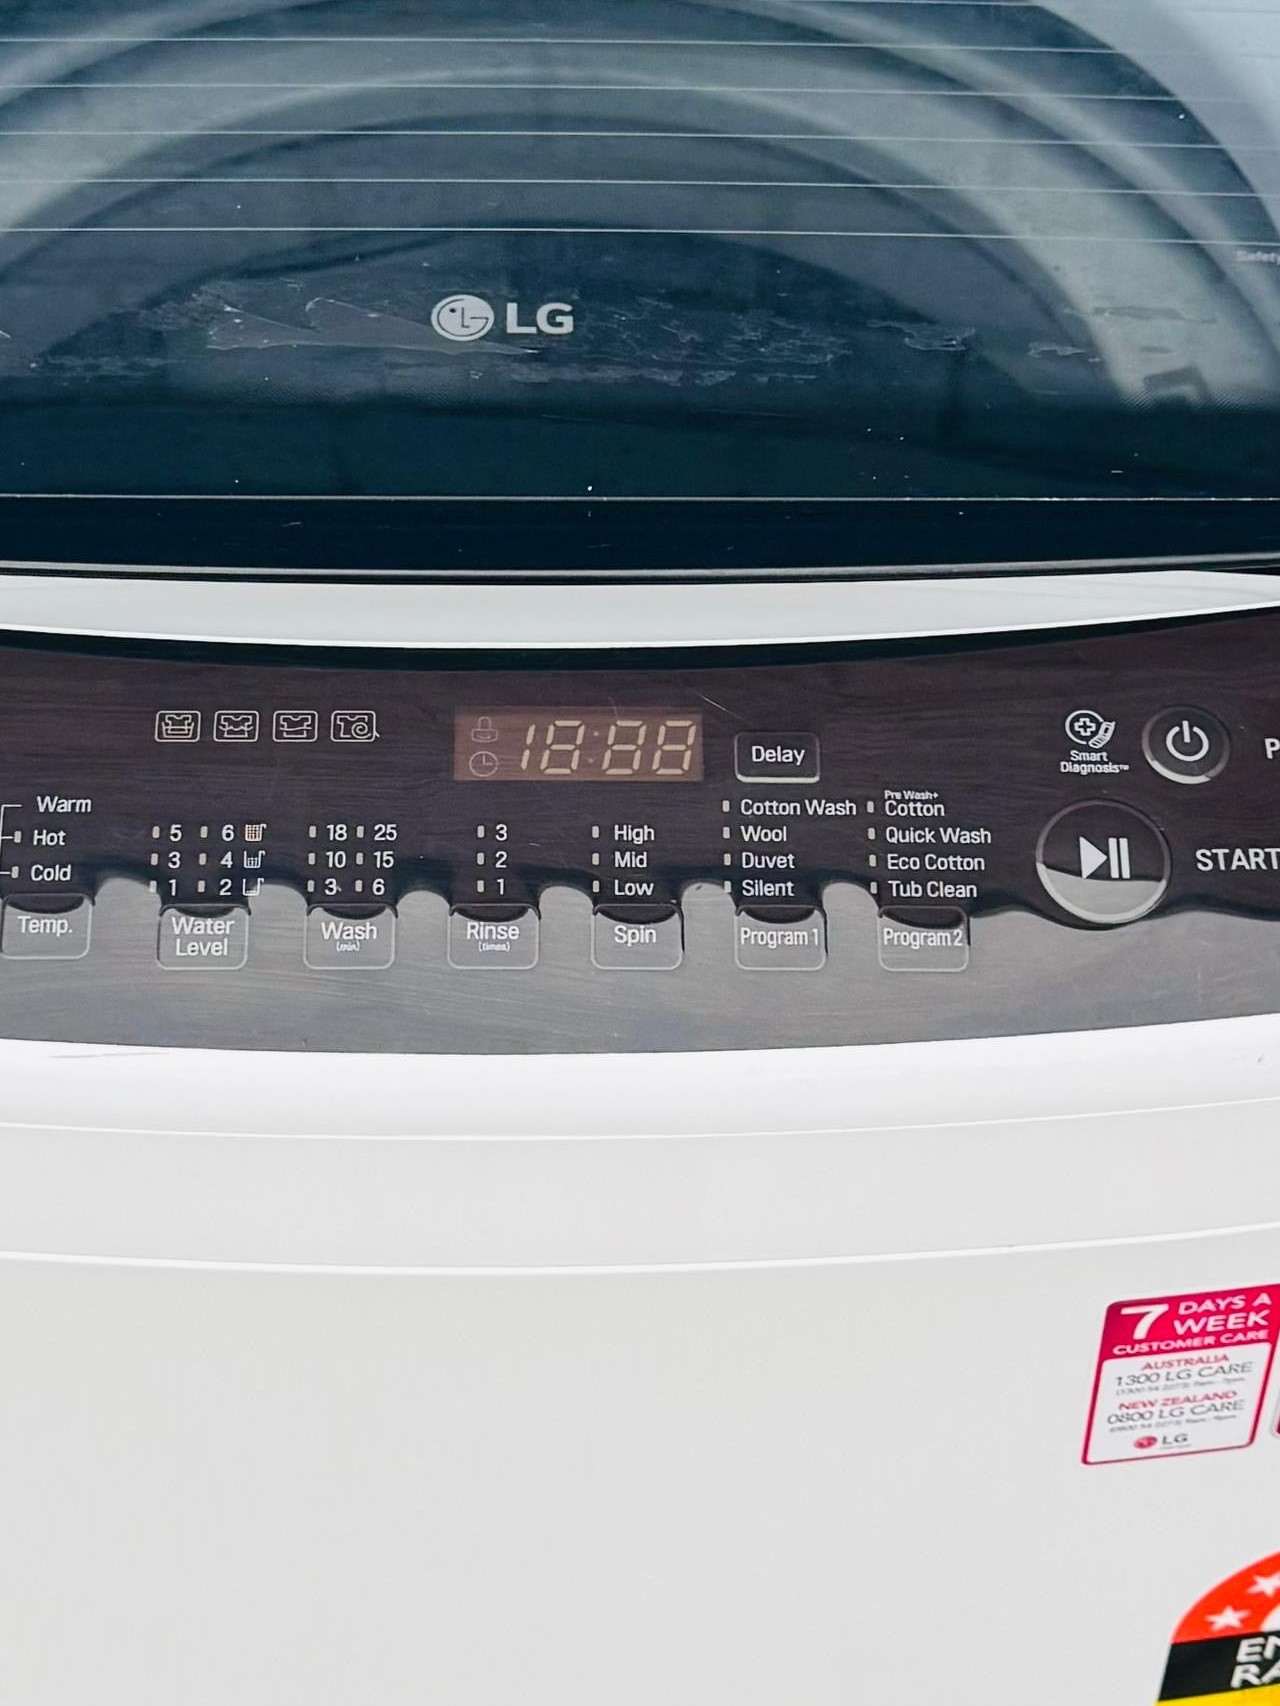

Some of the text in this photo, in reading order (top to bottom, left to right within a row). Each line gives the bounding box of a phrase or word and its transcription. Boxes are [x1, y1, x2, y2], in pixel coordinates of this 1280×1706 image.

[505, 302, 575, 335] LG
[751, 746, 806, 766] Delay
[1070, 749, 1109, 761] Smart
[884, 789, 902, 800] Pre
[37, 796, 92, 813] Warm
[740, 799, 858, 817] Cotton Wash
[884, 800, 946, 817] Cotton
[33, 829, 66, 847] Hot
[169, 824, 235, 842] 5 6
[327, 824, 399, 842] 18 25
[495, 824, 508, 842] 3
[614, 824, 655, 844] High
[740, 826, 788, 843] Wool
[885, 826, 992, 844] Quick Wash
[168, 851, 234, 869] 3 4
[326, 851, 395, 869] 10 15
[495, 851, 508, 869] 2
[614, 851, 648, 869] Mid
[741, 852, 796, 870] Duvet
[887, 853, 986, 871] Eco Cotton
[30, 864, 72, 881] Cold
[169, 878, 232, 896] 1 2
[324, 878, 386, 896] 3 6
[497, 878, 506, 896] 1
[614, 878, 655, 897] Low
[741, 879, 795, 897] Silent
[887, 880, 978, 898] Tub Clean
[18, 916, 74, 937] Temp.
[171, 917, 236, 935] Water
[321, 921, 378, 941] Wash
[467, 921, 520, 941] Rinse
[614, 925, 657, 946] Spin
[740, 927, 819, 950] Program 1
[882, 926, 963, 950] Program 2
[175, 938, 229, 957] Level
[1121, 1292, 1273, 1341] 7 DAYS A
[1173, 1309, 1271, 1336] WEEK
[1112, 1329, 1269, 1356] CUSTOMER CARE
[1141, 1353, 1230, 1372] AUSTRALIA
[1115, 1361, 1254, 1387] 1300 LG CARE
[1118, 1390, 1238, 1412] NEW ZEALAND
[1107, 1409, 1154, 1426] 0800
[1158, 1405, 1186, 1420] LG
[1189, 1399, 1246, 1417] CARE
[1161, 1432, 1189, 1446] LG
